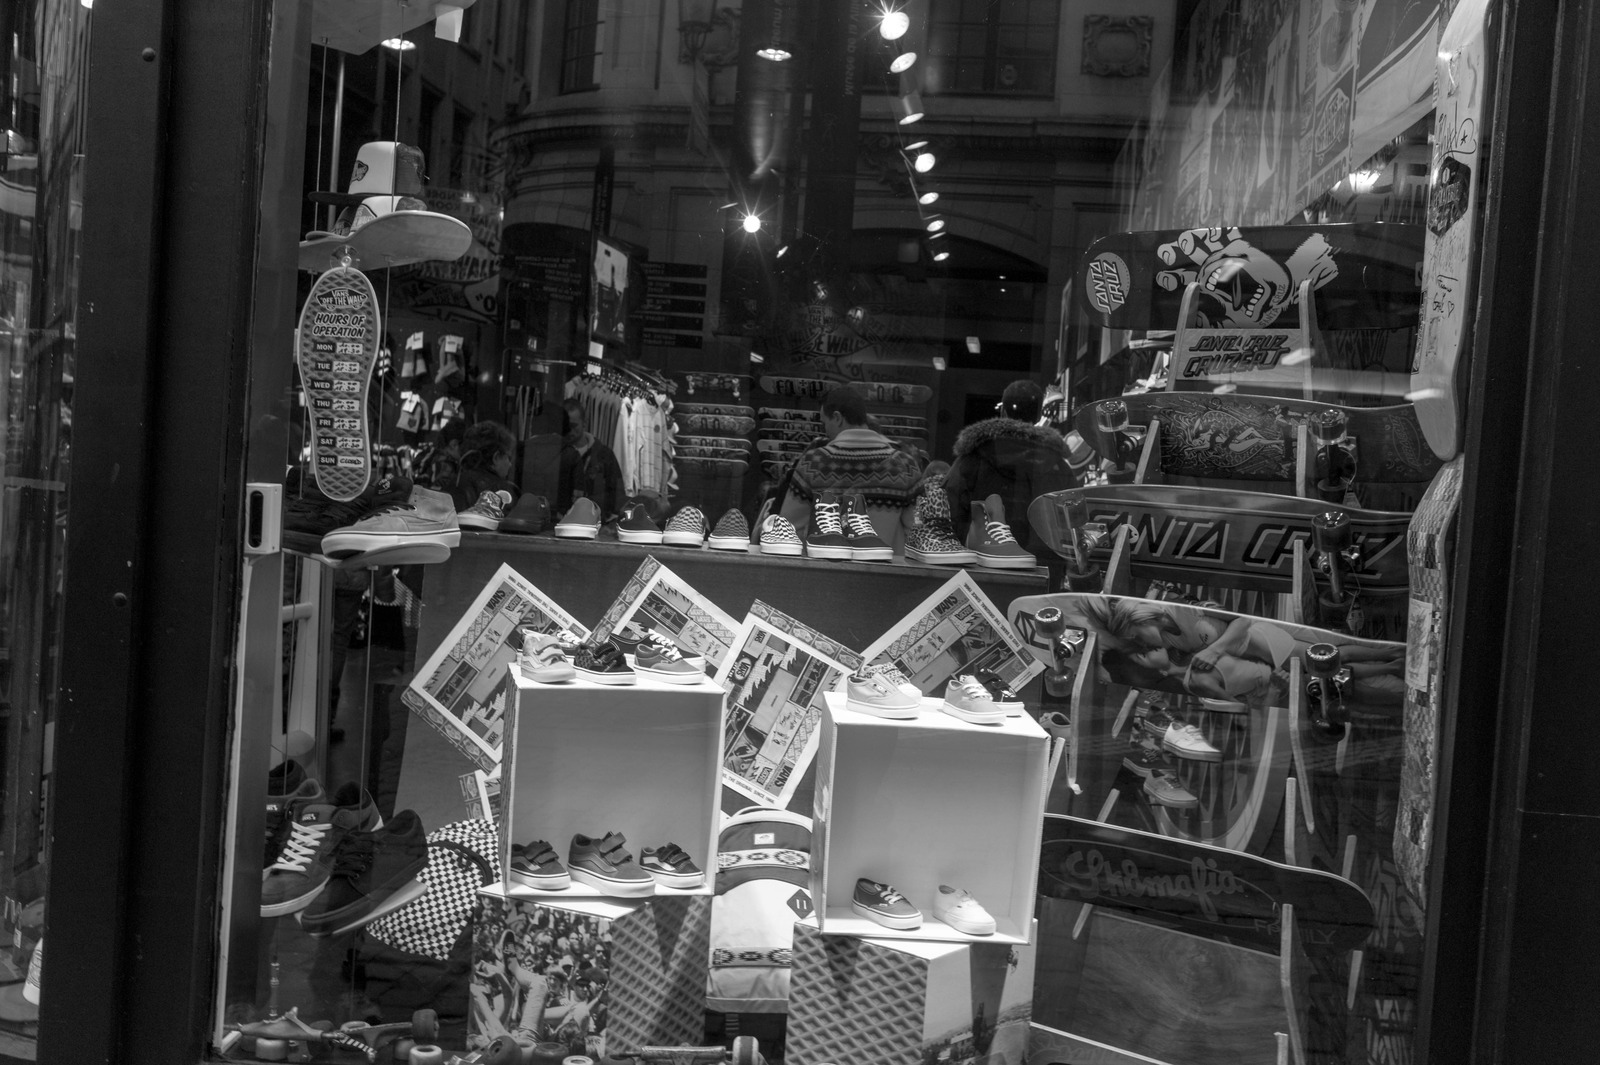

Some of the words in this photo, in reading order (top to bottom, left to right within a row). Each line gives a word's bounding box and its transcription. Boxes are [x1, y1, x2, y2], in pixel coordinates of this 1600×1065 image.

[1090, 262, 1111, 314] SANTA
[1103, 262, 1124, 304] CRUZ
[1260, 306, 1280, 327] SANTA
[1273, 284, 1286, 304] CRUZ
[315, 313, 350, 325] HOURS
[351, 314, 366, 326] OF
[313, 325, 365, 338] OPERATION
[1189, 336, 1242, 352] SANTA
[1242, 335, 1289, 352] CRUZ
[1183, 346, 1292, 378] CRUZERS
[1242, 523, 1405, 579] CRZ
[486, 590, 506, 610] VANS
[934, 594, 958, 614] VANS
[971, 592, 981, 602] SINCE
[754, 630, 767, 644] VANS
[736, 662, 751, 678] VANS
[774, 765, 793, 788] VANS
[1254, 918, 1337, 945] FAILY
